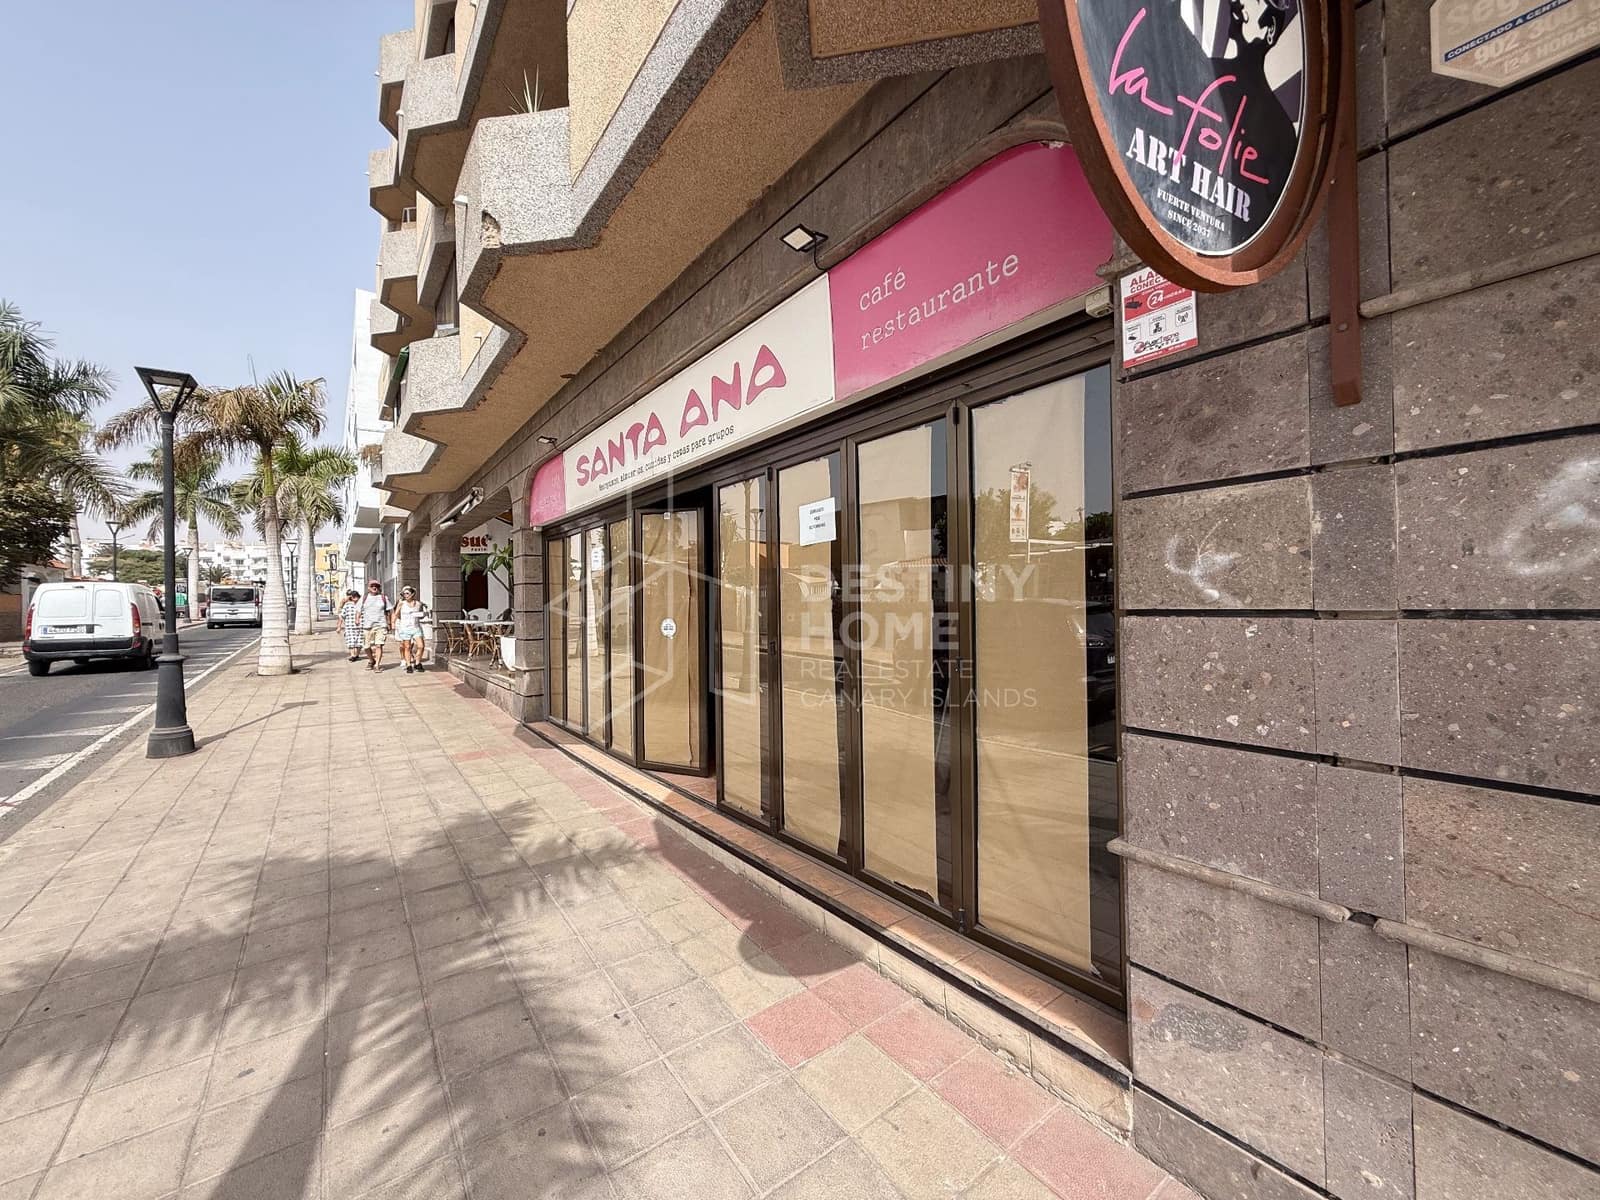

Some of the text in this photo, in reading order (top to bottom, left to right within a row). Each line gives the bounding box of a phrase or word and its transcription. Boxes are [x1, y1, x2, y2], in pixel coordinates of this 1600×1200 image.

[1446, 23, 1513, 60] CONECTADO
[1515, 17, 1524, 26] A
[1125, 127, 1251, 222] ART HAIR
[1157, 188, 1225, 231] FUERTE VENTURA
[1167, 210, 1193, 228] SINCE
[859, 266, 906, 311] café
[1129, 271, 1160, 288] ALA
[1130, 276, 1163, 293] CONEC
[1151, 295, 1164, 306] 24
[860, 254, 1019, 350] restaurante
[576, 344, 787, 486] SANTA ANA
[691, 437, 706, 452] para
[707, 425, 735, 445] grupos
